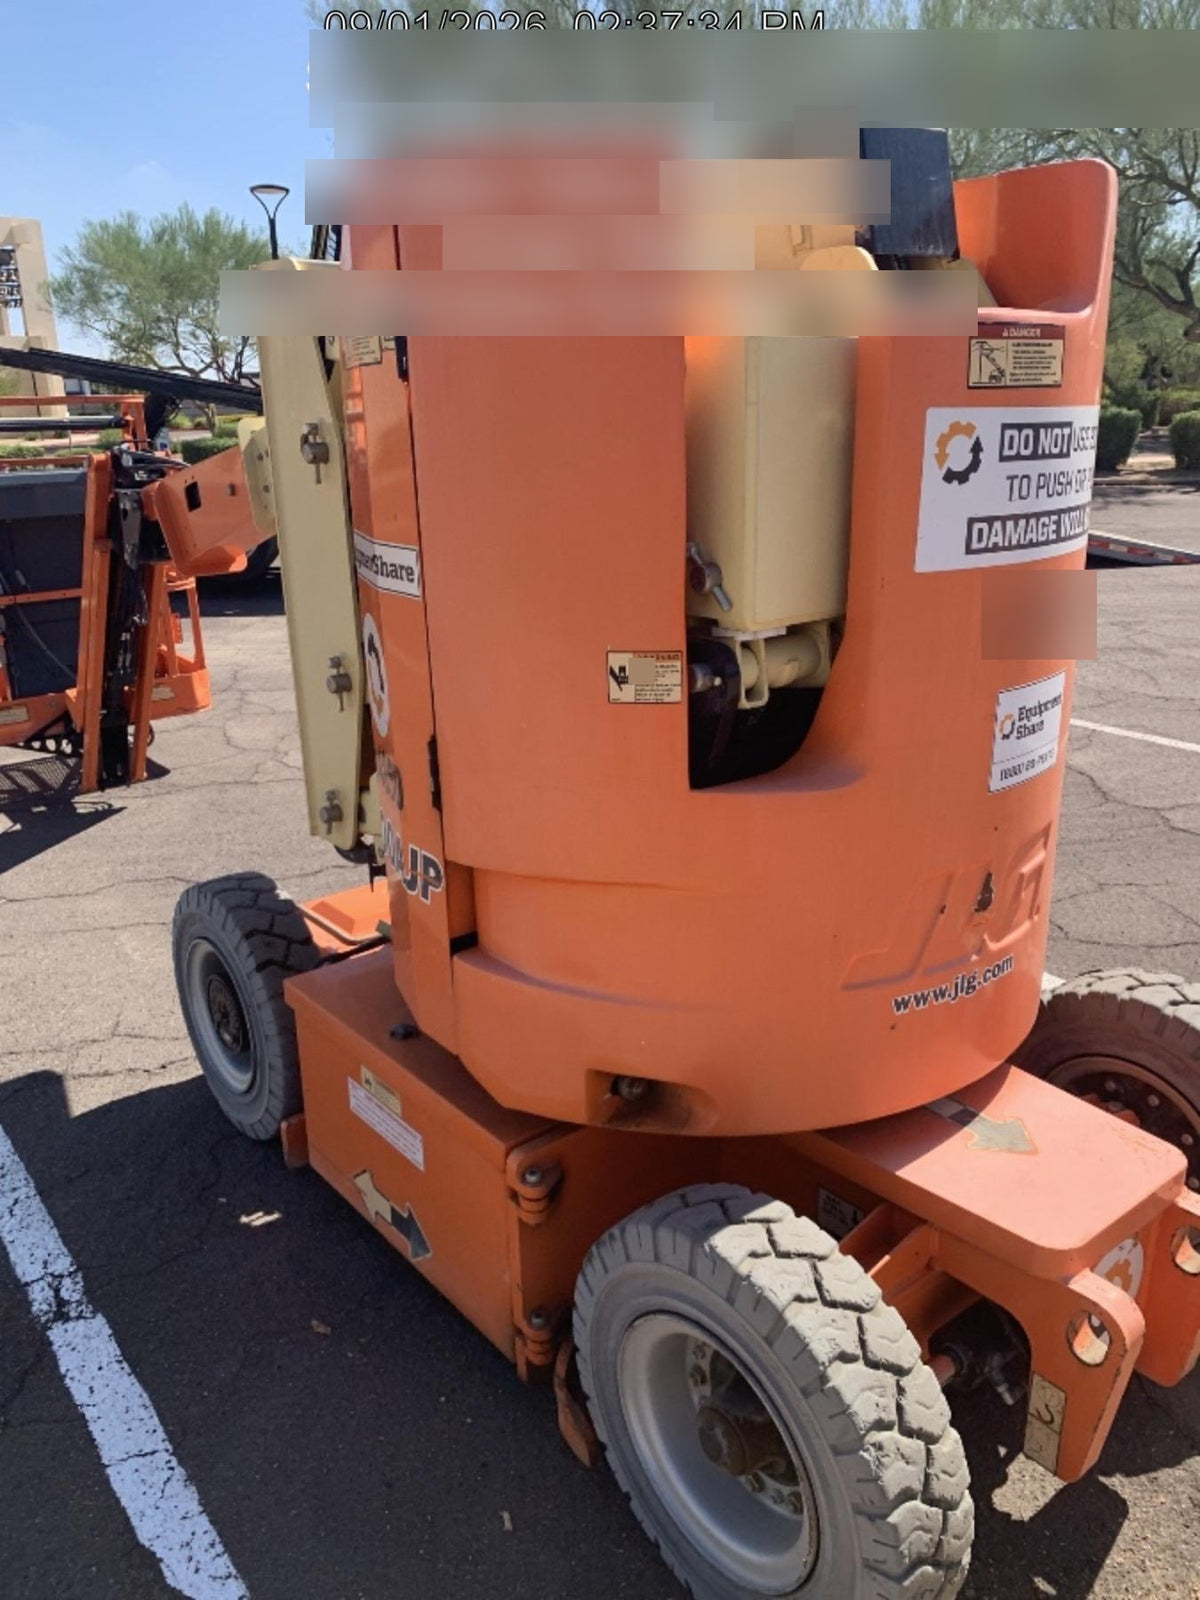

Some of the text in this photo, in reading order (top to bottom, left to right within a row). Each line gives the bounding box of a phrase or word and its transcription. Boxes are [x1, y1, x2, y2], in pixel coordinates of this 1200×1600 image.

[1002, 428, 1034, 456] DO
[1038, 427, 1071, 456] NOT
[1006, 474, 1031, 502] TO
[1036, 470, 1072, 499] PUSH
[970, 515, 1057, 549] DAMAGE
[1016, 720, 1045, 741] Share
[892, 954, 1014, 1014] www.jlg.com
